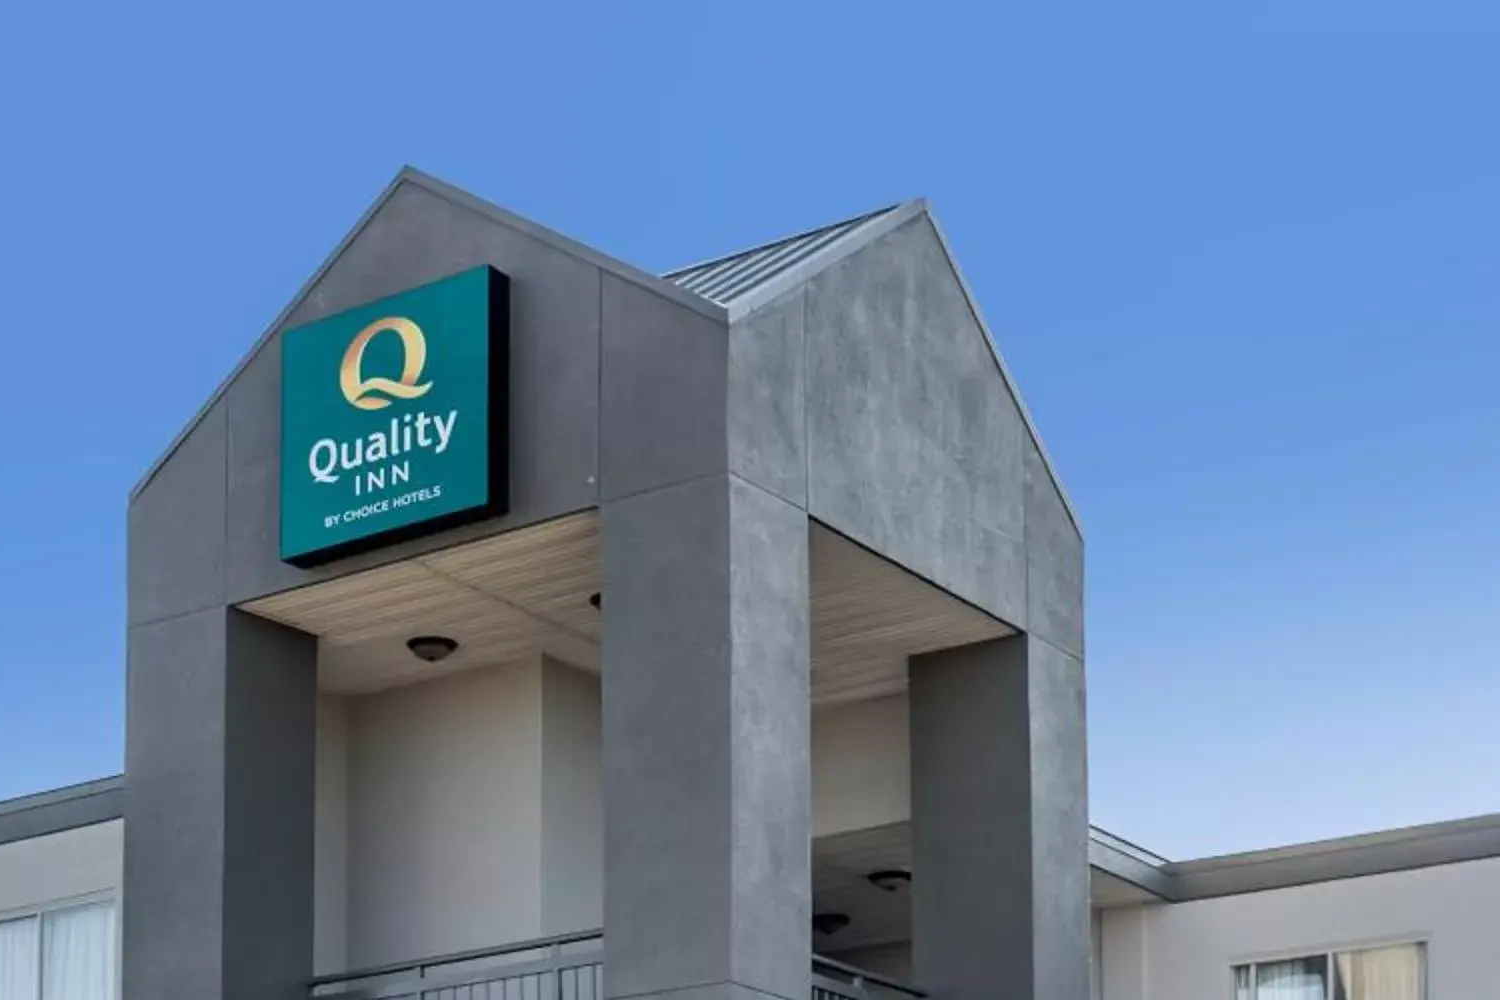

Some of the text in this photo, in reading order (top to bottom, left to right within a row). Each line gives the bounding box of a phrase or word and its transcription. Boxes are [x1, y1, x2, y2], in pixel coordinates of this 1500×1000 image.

[339, 315, 433, 411] Q
[308, 410, 458, 483] Quality
[324, 485, 441, 528] BY CHOICE HOTELS
[355, 461, 410, 496] INN
